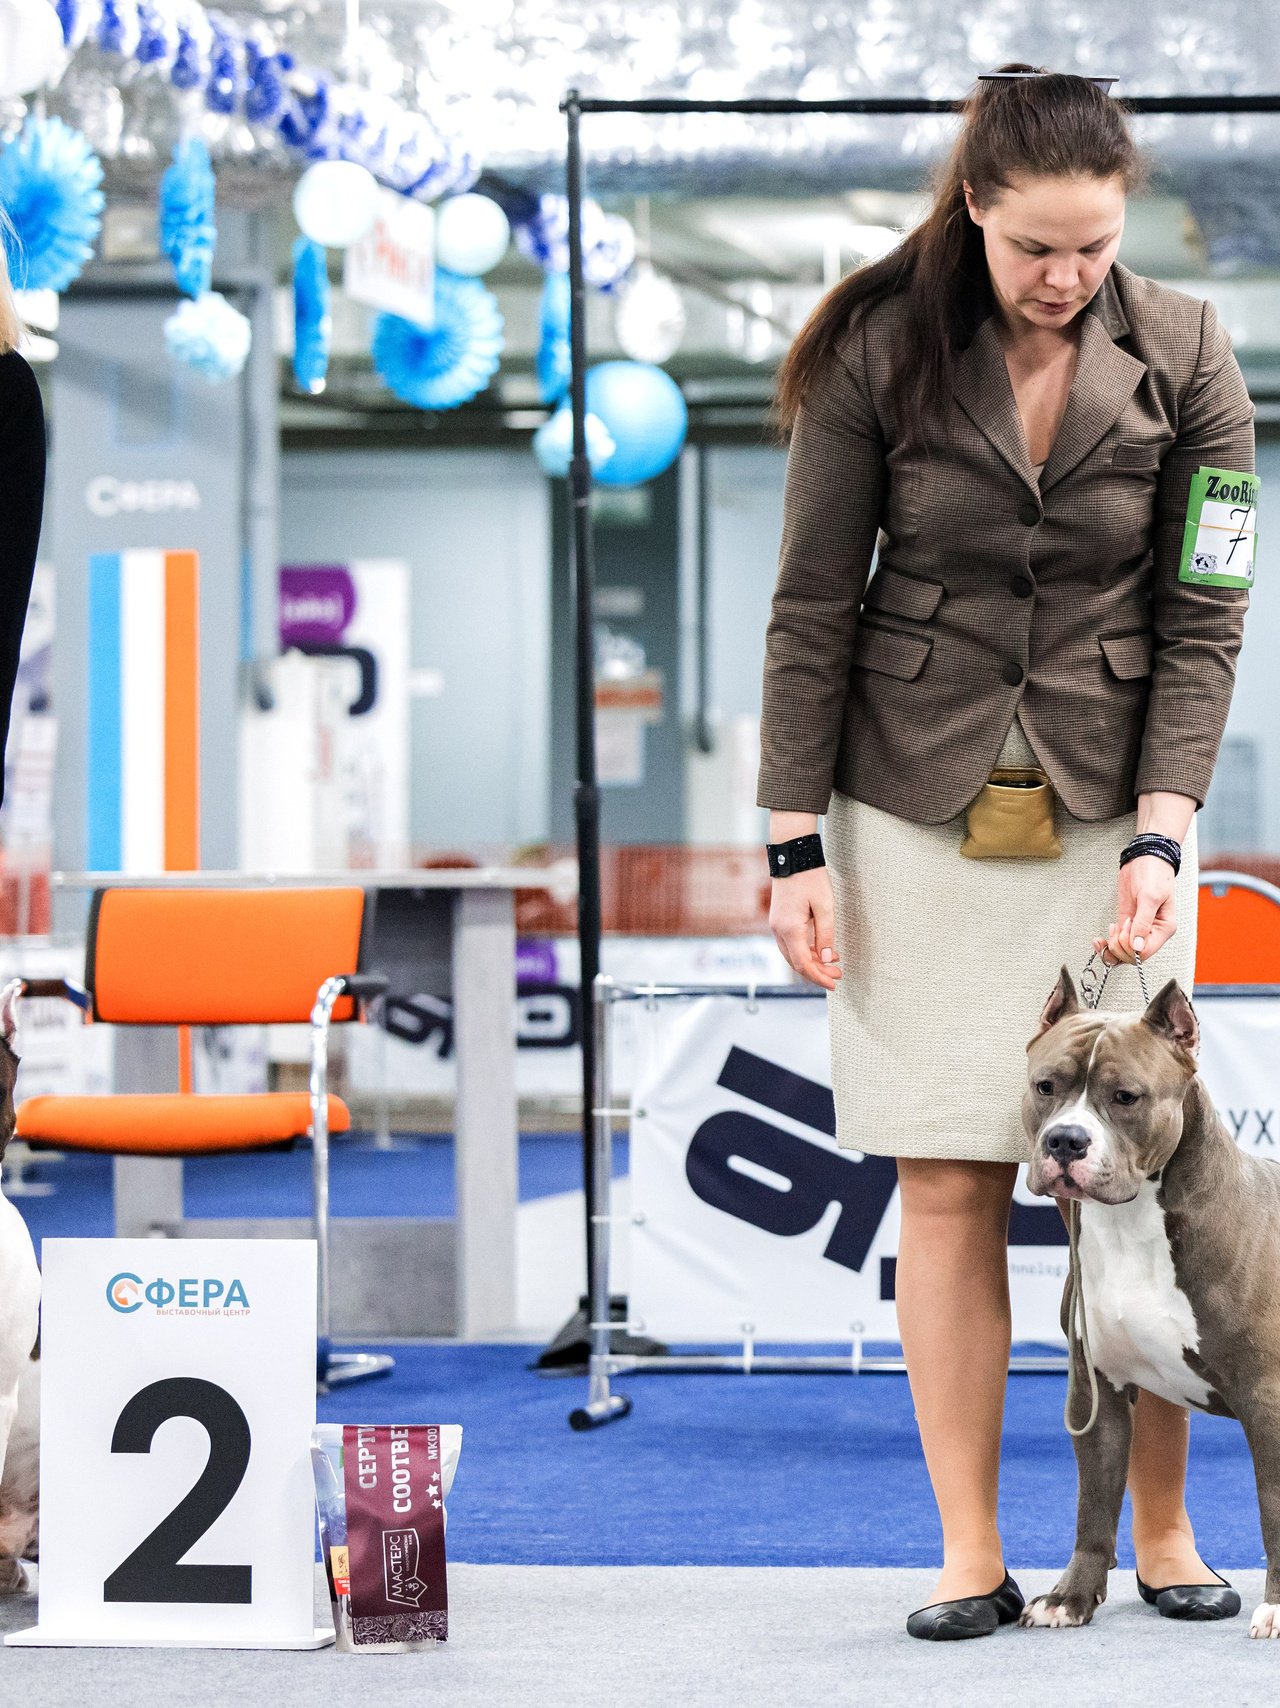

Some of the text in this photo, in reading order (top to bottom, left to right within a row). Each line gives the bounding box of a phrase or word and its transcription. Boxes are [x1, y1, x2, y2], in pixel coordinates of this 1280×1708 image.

[1226, 506, 1252, 565] 7
[106, 1272, 250, 1313] СФЕРА
[156, 1308, 251, 1317] ВЫСТАВОЧНЫЙ ЦЕНТР
[103, 1376, 252, 1604] 2
[391, 1425, 412, 1513] СООТВЕ
[390, 1535, 405, 1598] МАСТЕРС
